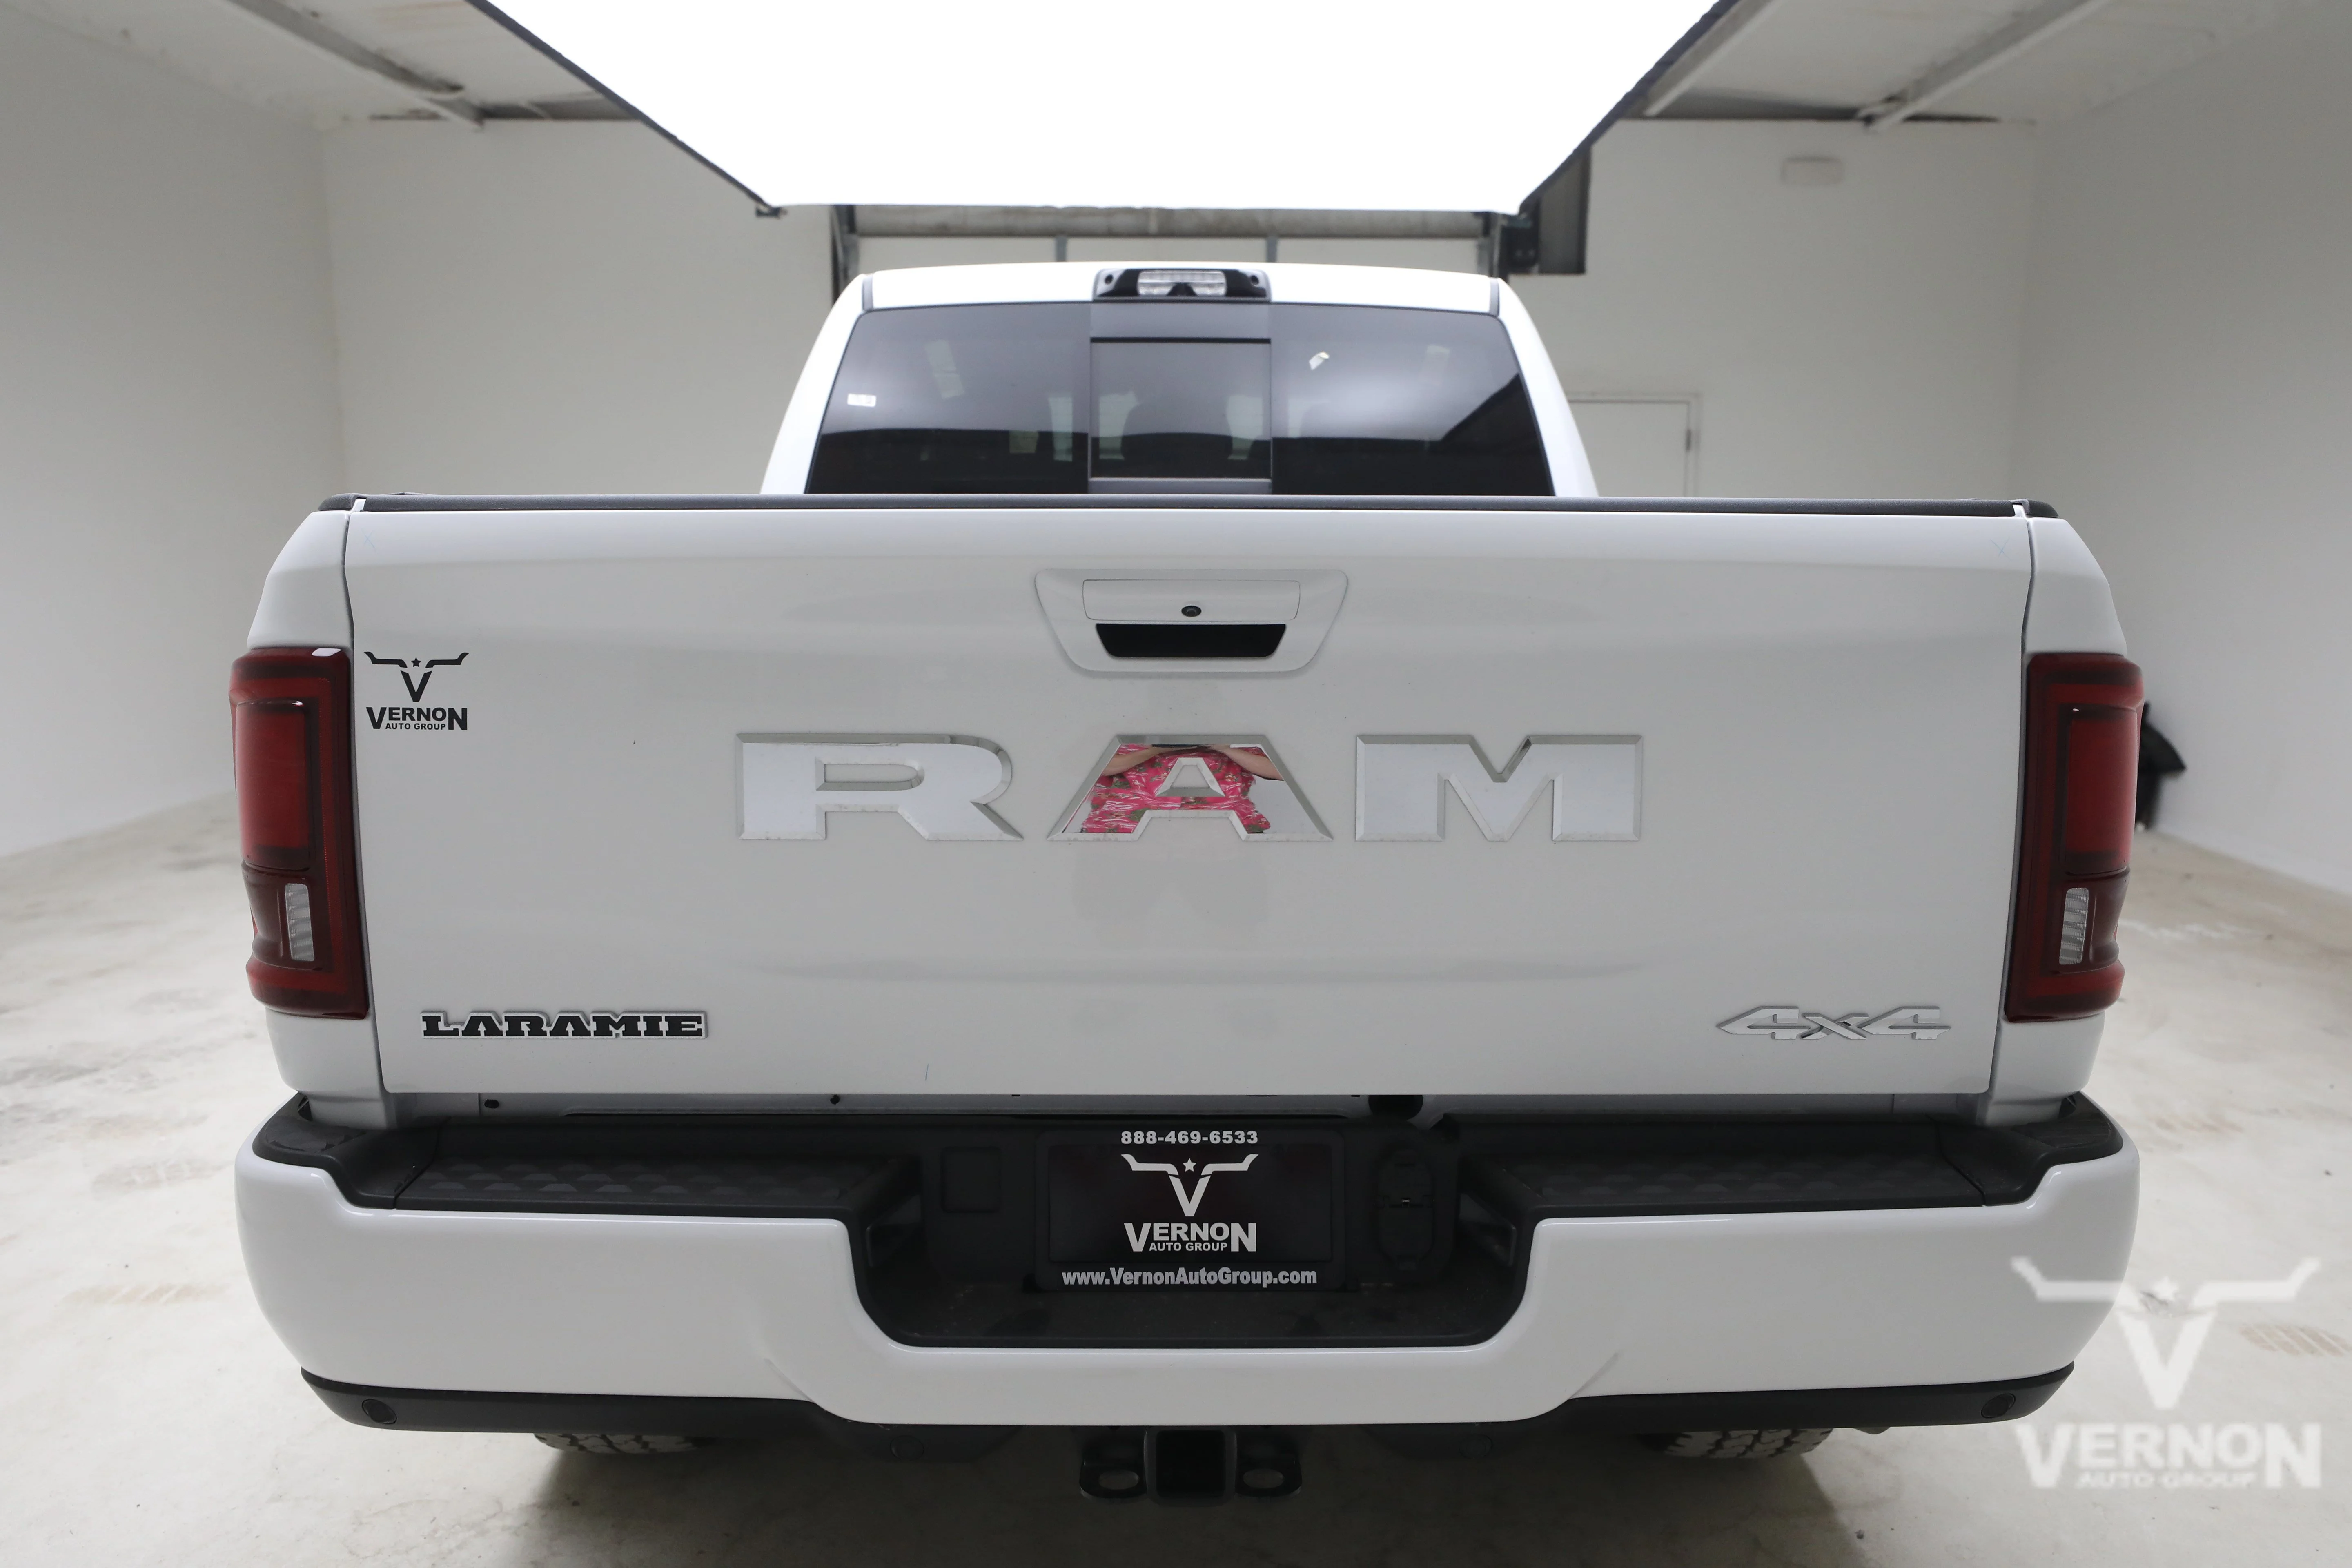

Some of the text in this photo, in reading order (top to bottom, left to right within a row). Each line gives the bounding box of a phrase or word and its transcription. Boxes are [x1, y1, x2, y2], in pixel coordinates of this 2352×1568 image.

[366, 707, 468, 731] VERNON
[736, 733, 1644, 842] RAM
[421, 1011, 707, 1039] LARAMIE
[1120, 1131, 1259, 1145] 888-469-6533
[1124, 1222, 1257, 1252] VERNON
[1149, 1242, 1227, 1252] AUTO GROUP
[1062, 1267, 1318, 1288] www.VernonAutoGroup.com
